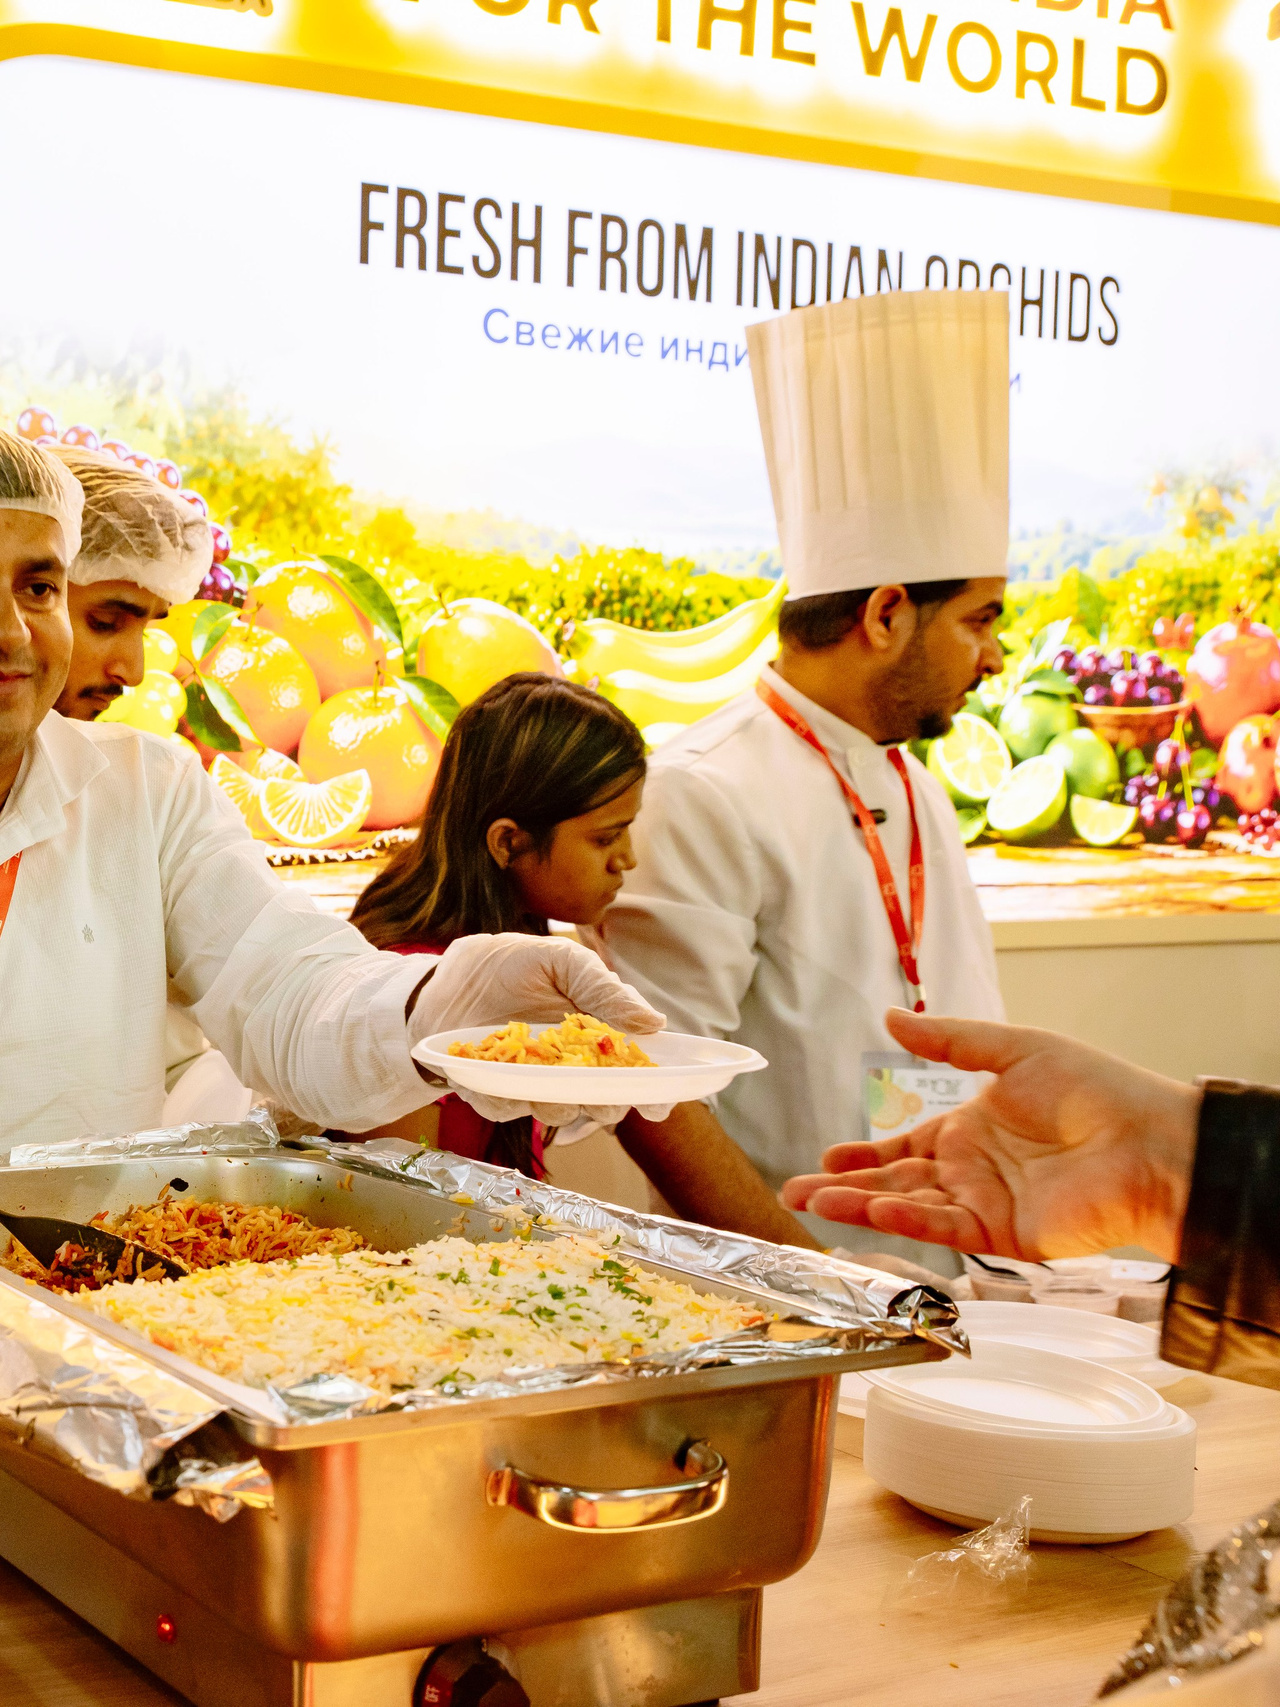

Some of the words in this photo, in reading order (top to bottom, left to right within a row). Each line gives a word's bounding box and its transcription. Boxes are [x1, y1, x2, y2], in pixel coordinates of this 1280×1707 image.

[850, 1, 1168, 116] WORLD
[359, 182, 543, 284] FRESH
[566, 209, 714, 303] FROM
[736, 231, 903, 310] INDIAN
[483, 308, 644, 358] Свежие
